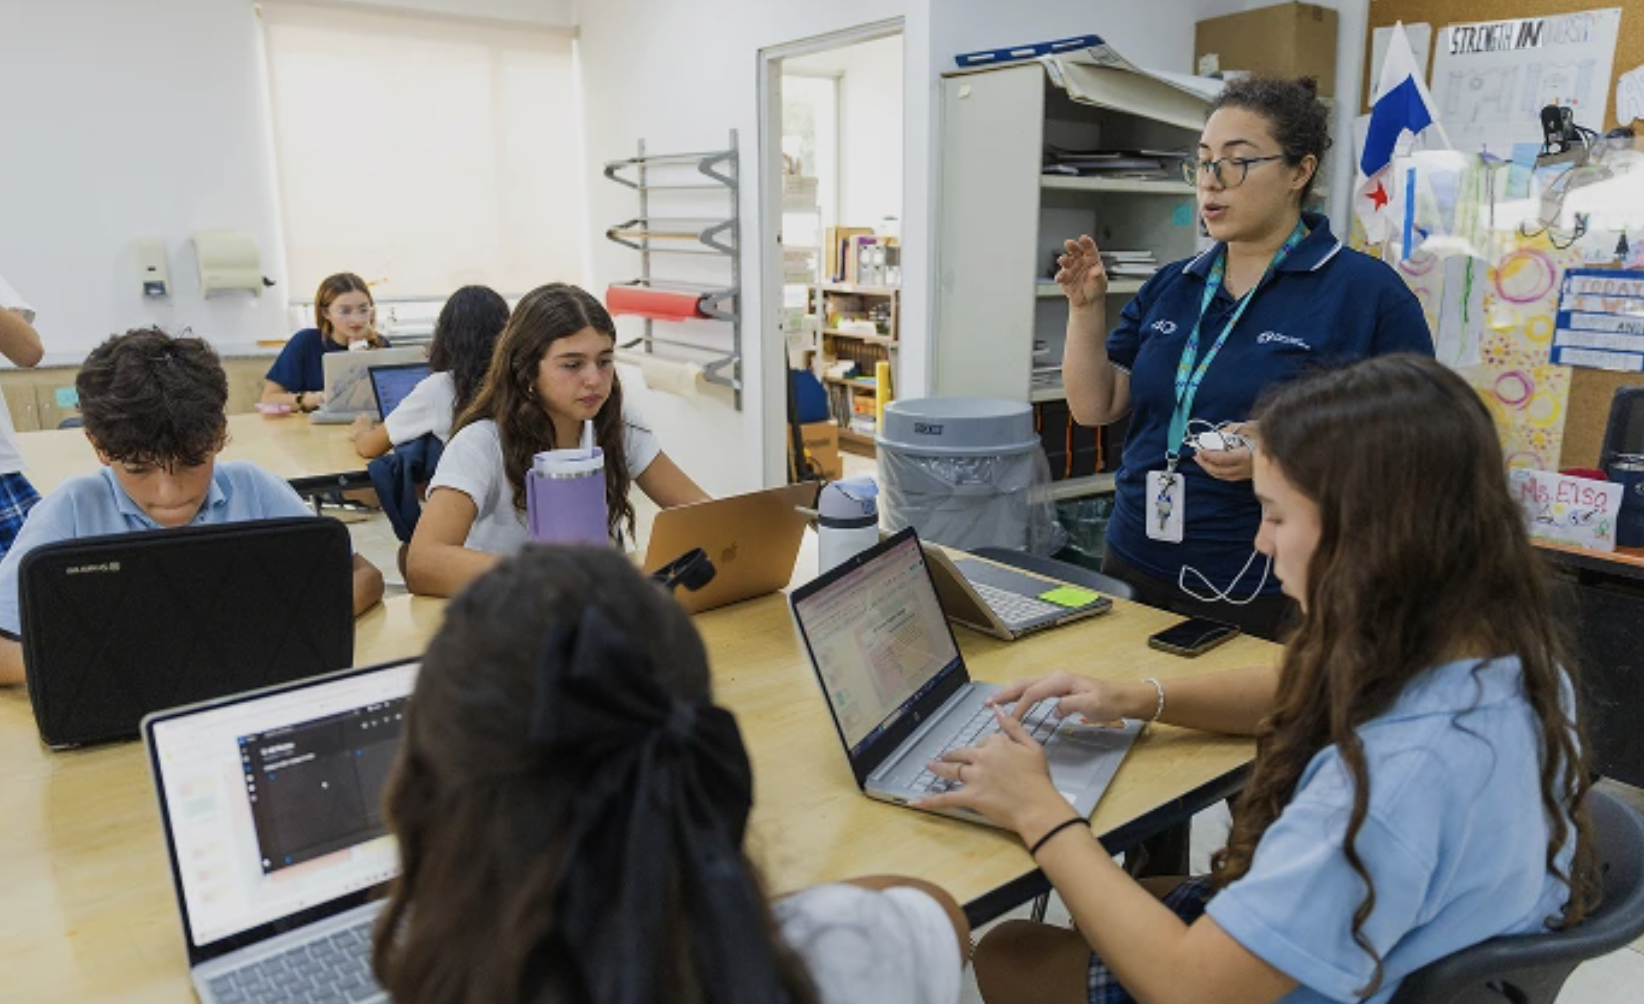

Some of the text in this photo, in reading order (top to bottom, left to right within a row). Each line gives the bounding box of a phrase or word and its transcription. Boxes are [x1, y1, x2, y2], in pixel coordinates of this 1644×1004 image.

[1450, 23, 1514, 55] STRENGTH
[1515, 20, 1543, 50] IN
[1581, 278, 1643, 295] TODAY
